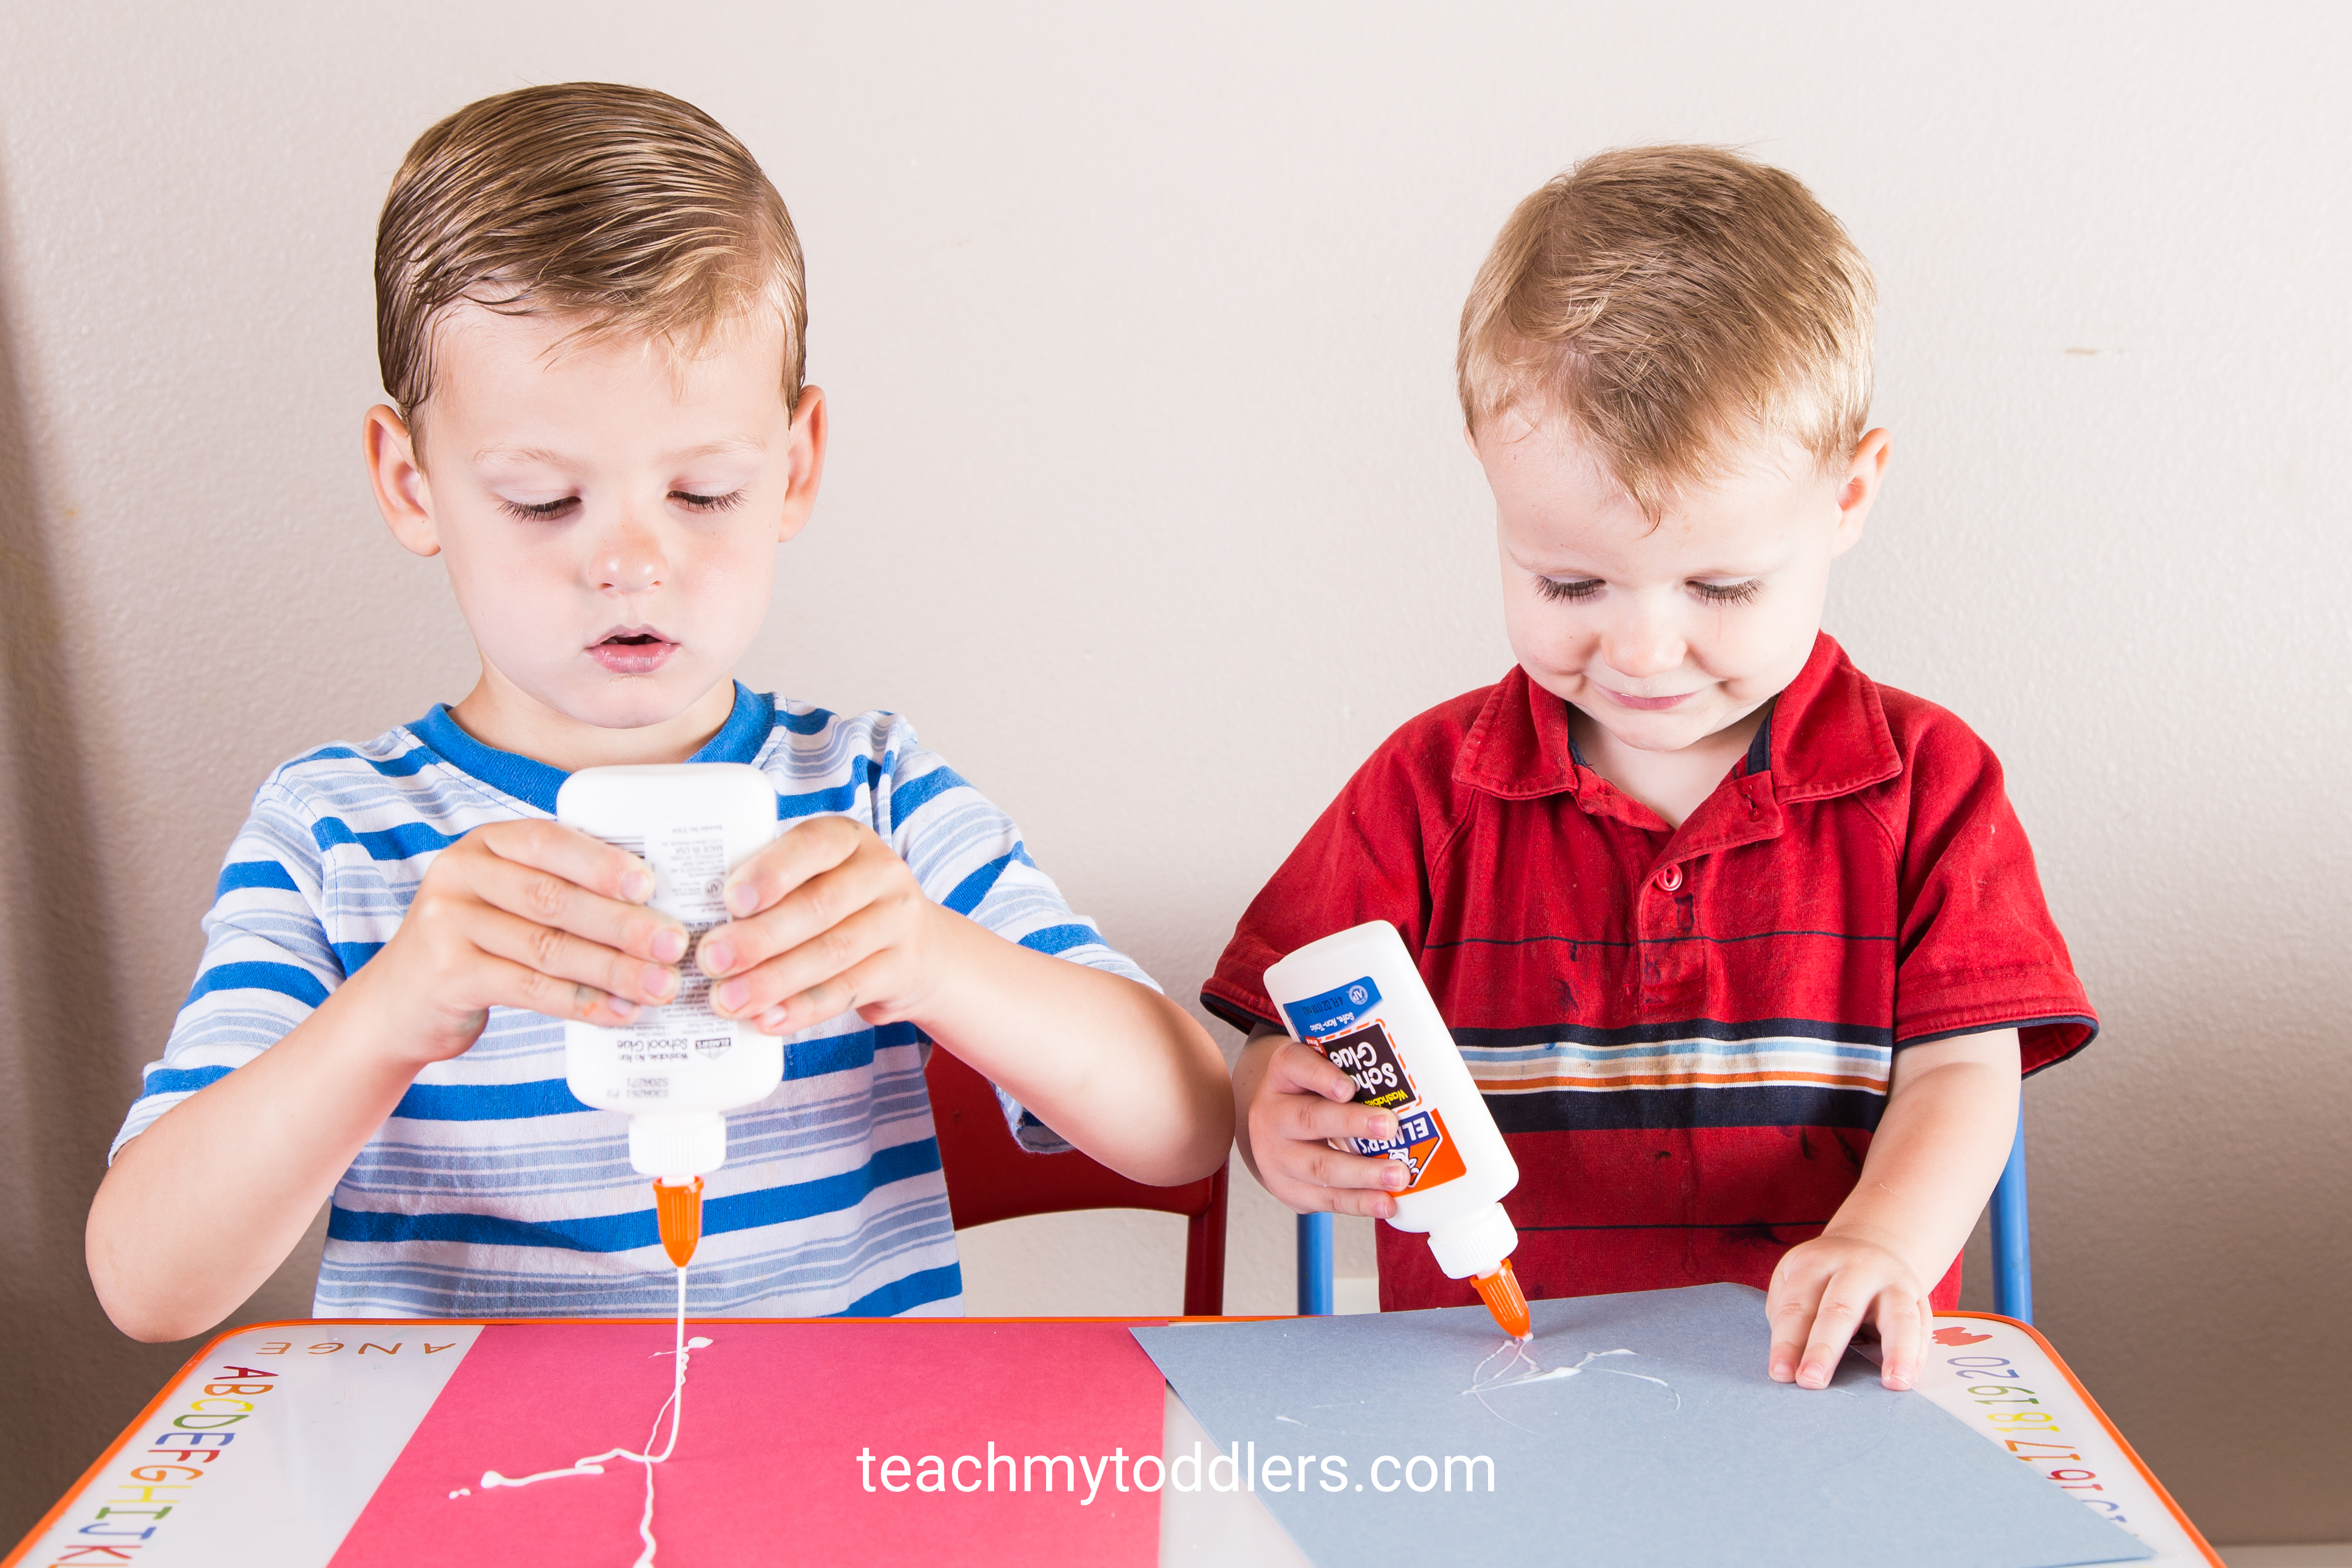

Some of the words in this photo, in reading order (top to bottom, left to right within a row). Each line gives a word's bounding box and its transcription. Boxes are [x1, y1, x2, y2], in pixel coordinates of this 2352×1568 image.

[1321, 999, 1332, 1011] OZ
[1331, 996, 1340, 1007] FL
[1337, 995, 1343, 1005] 4
[1310, 1020, 1338, 1032] Non-Toxic
[617, 1039, 644, 1051] Glue
[647, 1038, 688, 1051] School
[618, 1054, 633, 1062] Run
[635, 1053, 645, 1062] No
[1329, 1041, 1377, 1070] Glue
[1350, 1062, 1398, 1095] Sch
[1947, 1356, 2020, 1378] 20
[1967, 1385, 2040, 1405] 19
[1986, 1412, 2060, 1433] 18
[2004, 1439, 2081, 1461] 17
